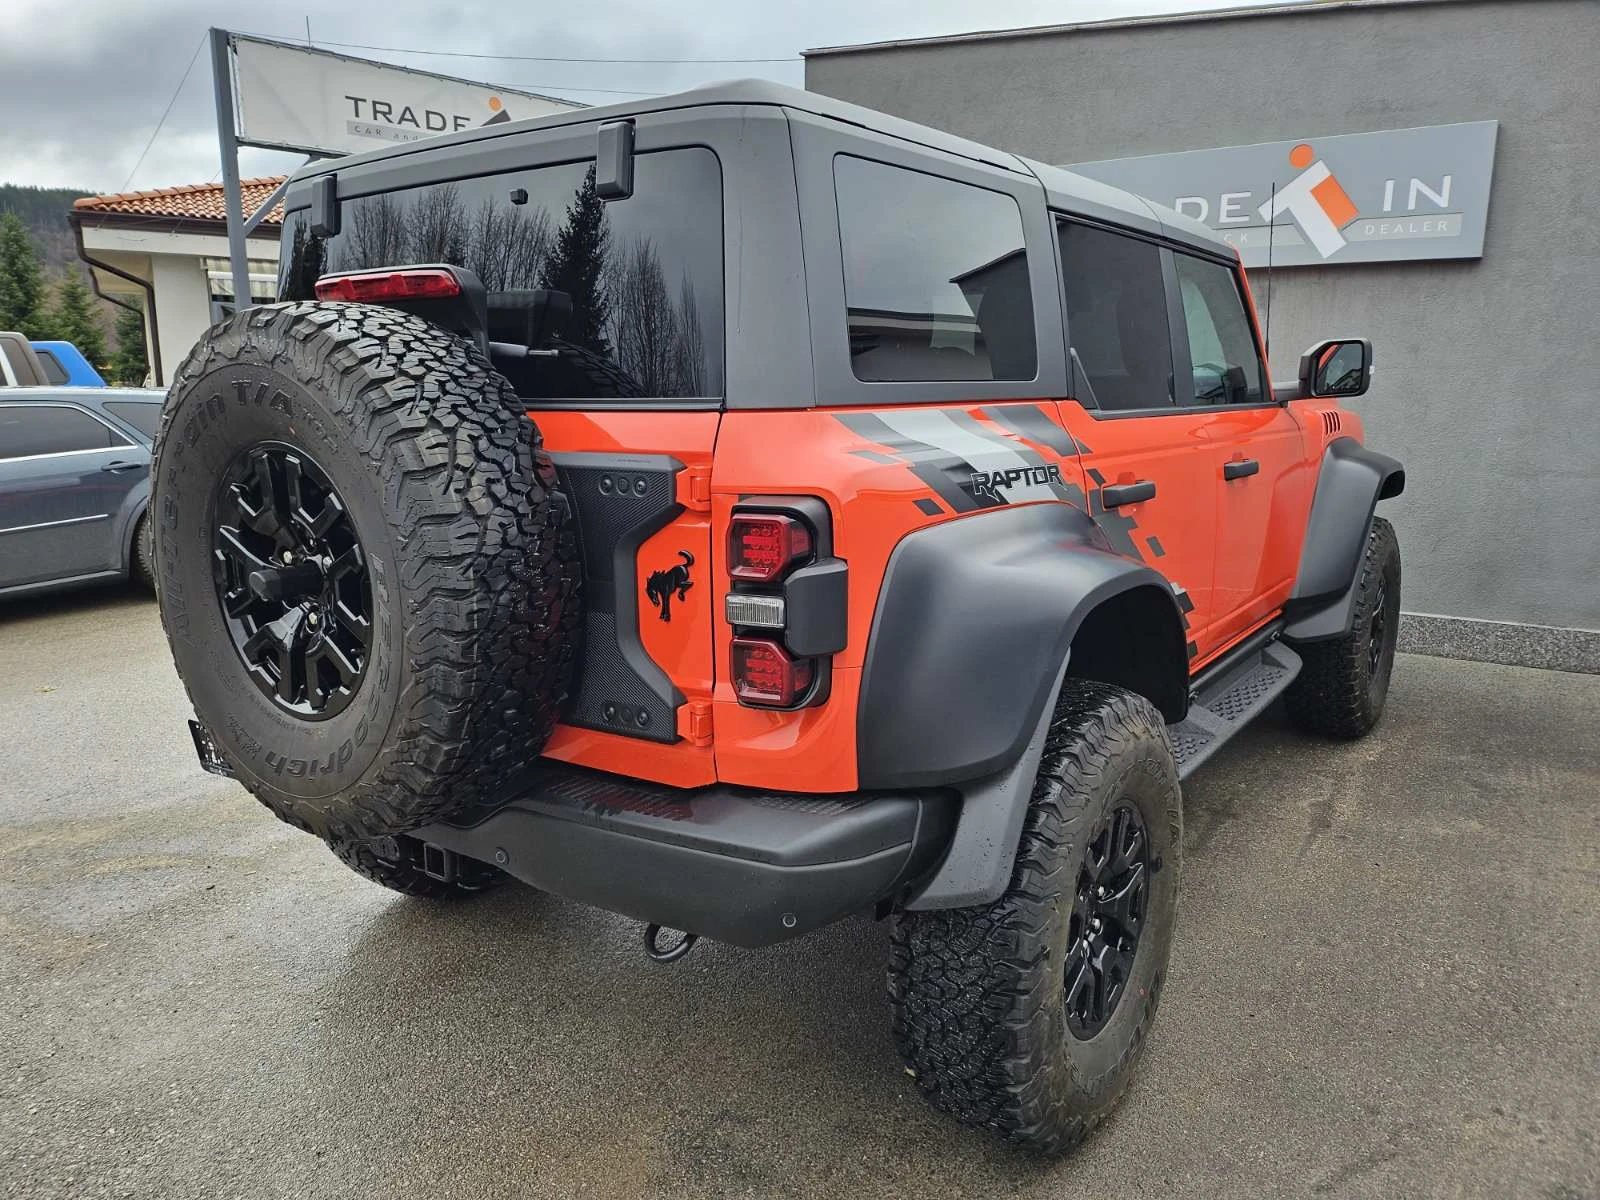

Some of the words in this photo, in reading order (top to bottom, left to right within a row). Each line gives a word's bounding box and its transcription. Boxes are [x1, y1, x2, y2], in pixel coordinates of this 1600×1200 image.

[344, 95, 472, 132] TRADE
[354, 125, 382, 136] CAR
[1383, 175, 1451, 212] IN
[1365, 220, 1448, 235] DEALER
[970, 463, 1068, 503] RAPTOR
